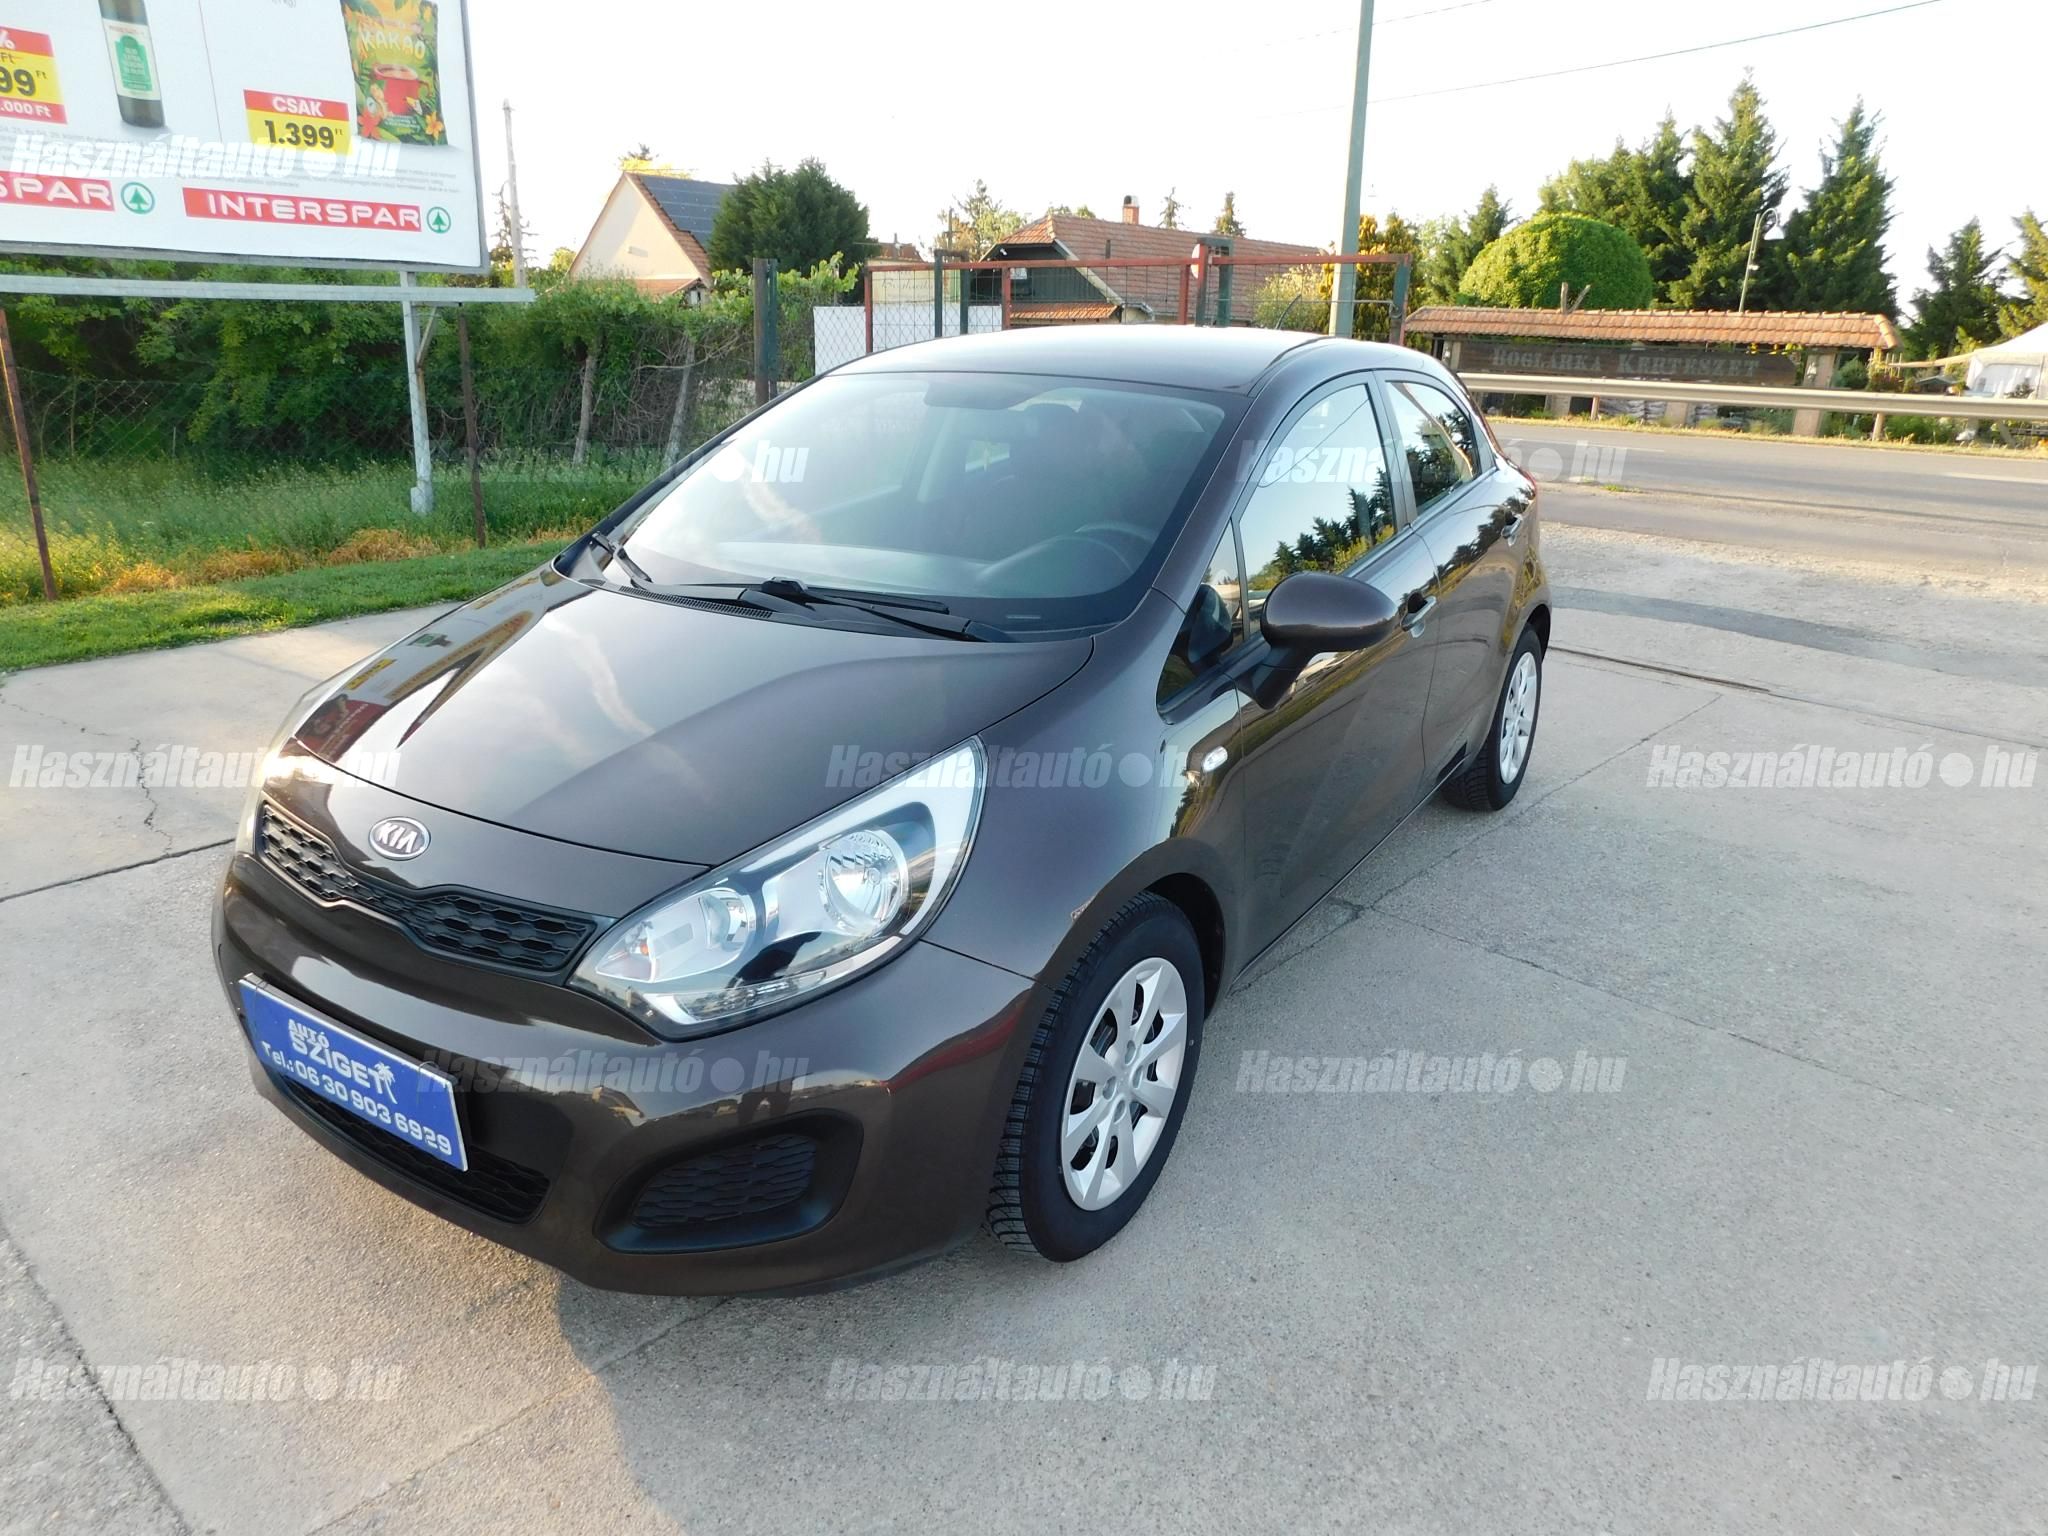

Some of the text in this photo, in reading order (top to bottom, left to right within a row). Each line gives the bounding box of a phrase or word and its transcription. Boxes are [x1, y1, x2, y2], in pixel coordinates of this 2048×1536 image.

[361, 30, 426, 60] KAKAO
[272, 96, 323, 117] CSAK
[264, 119, 334, 149] 1.399
[208, 193, 420, 229] INTERSPAR
[376, 822, 417, 853] KIA
[288, 1018, 329, 1048] AUTÓ
[296, 1061, 320, 1086] 06
[322, 1074, 349, 1101] 30
[350, 1089, 391, 1125] 903
[395, 1112, 452, 1156] 6929
